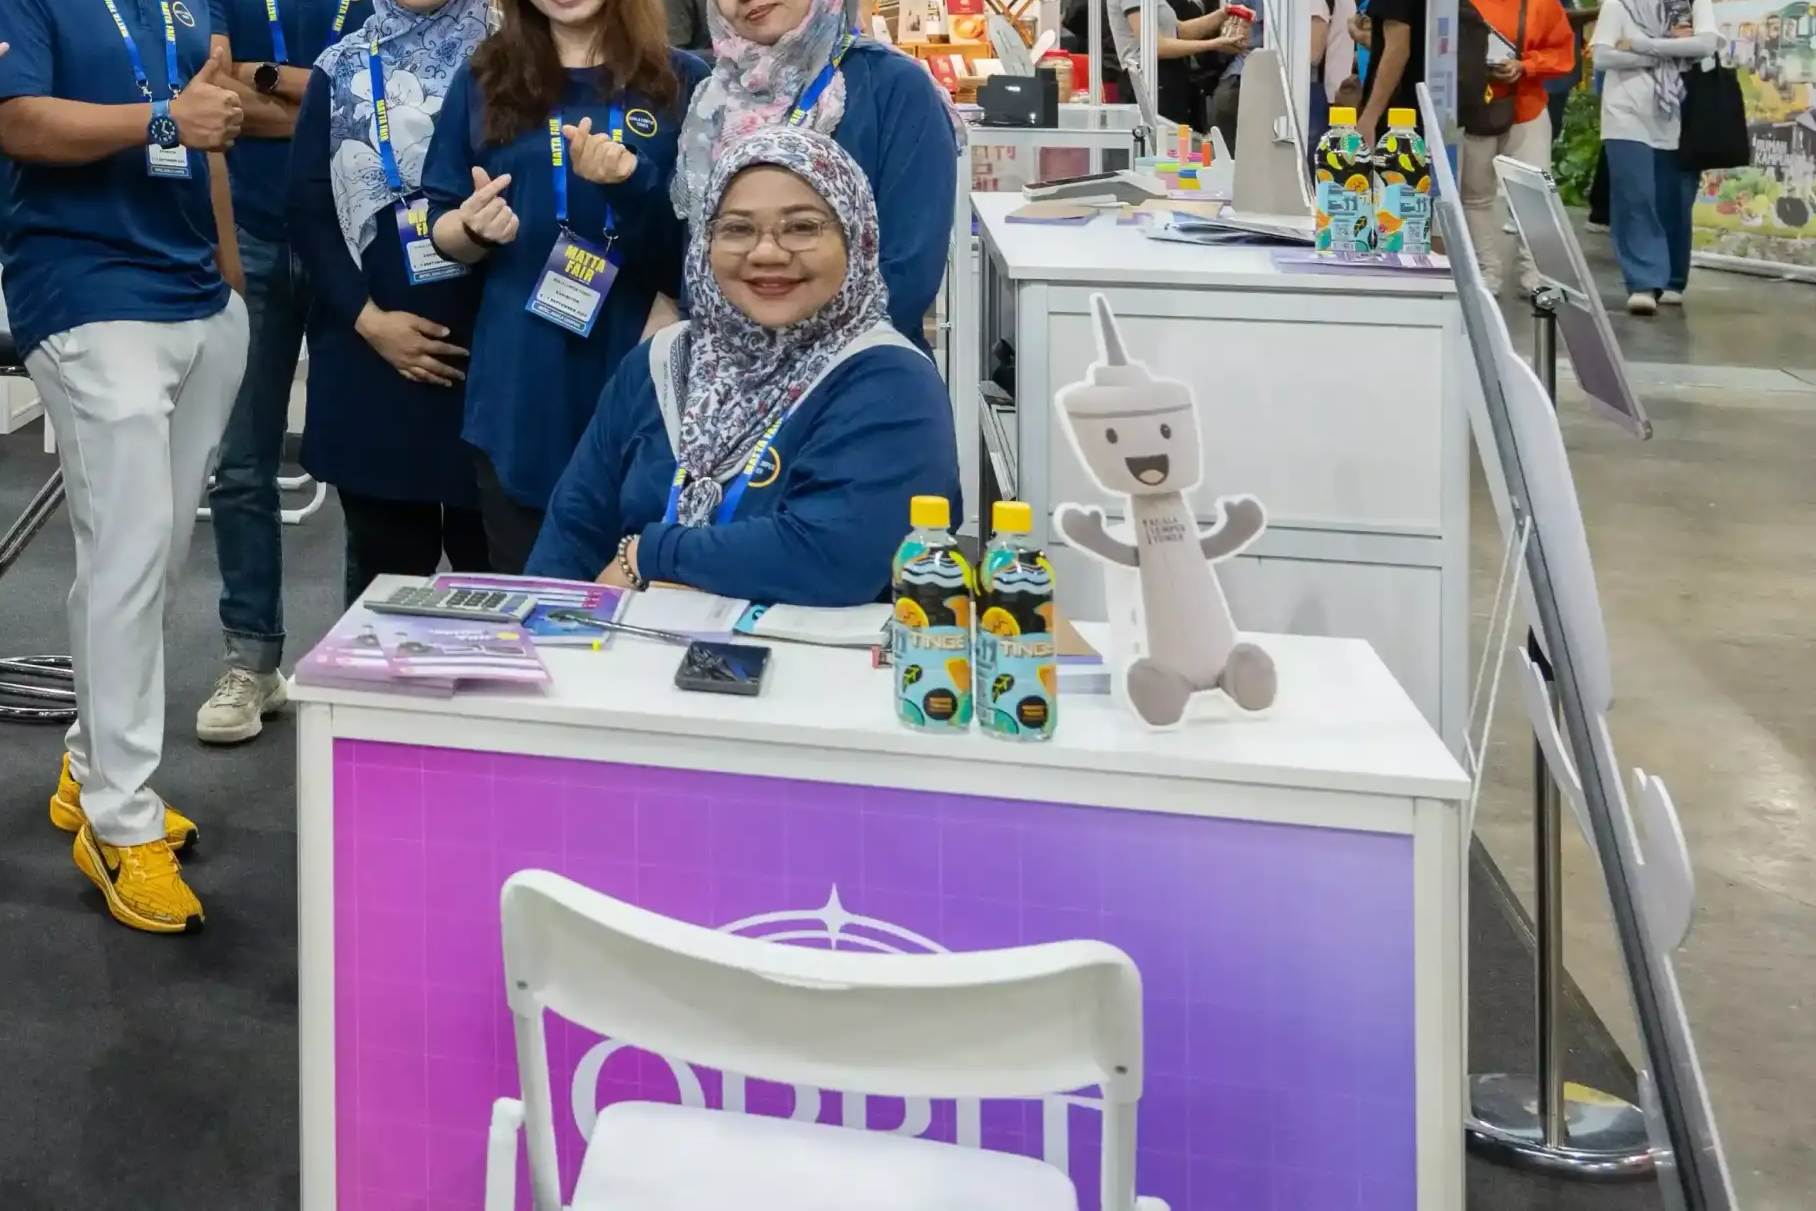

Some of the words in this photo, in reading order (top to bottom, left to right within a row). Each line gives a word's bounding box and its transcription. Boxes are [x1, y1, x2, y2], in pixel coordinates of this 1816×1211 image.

[550, 137, 564, 167] MATTA
[564, 244, 606, 273] MATTA
[565, 260, 595, 282] FAIR
